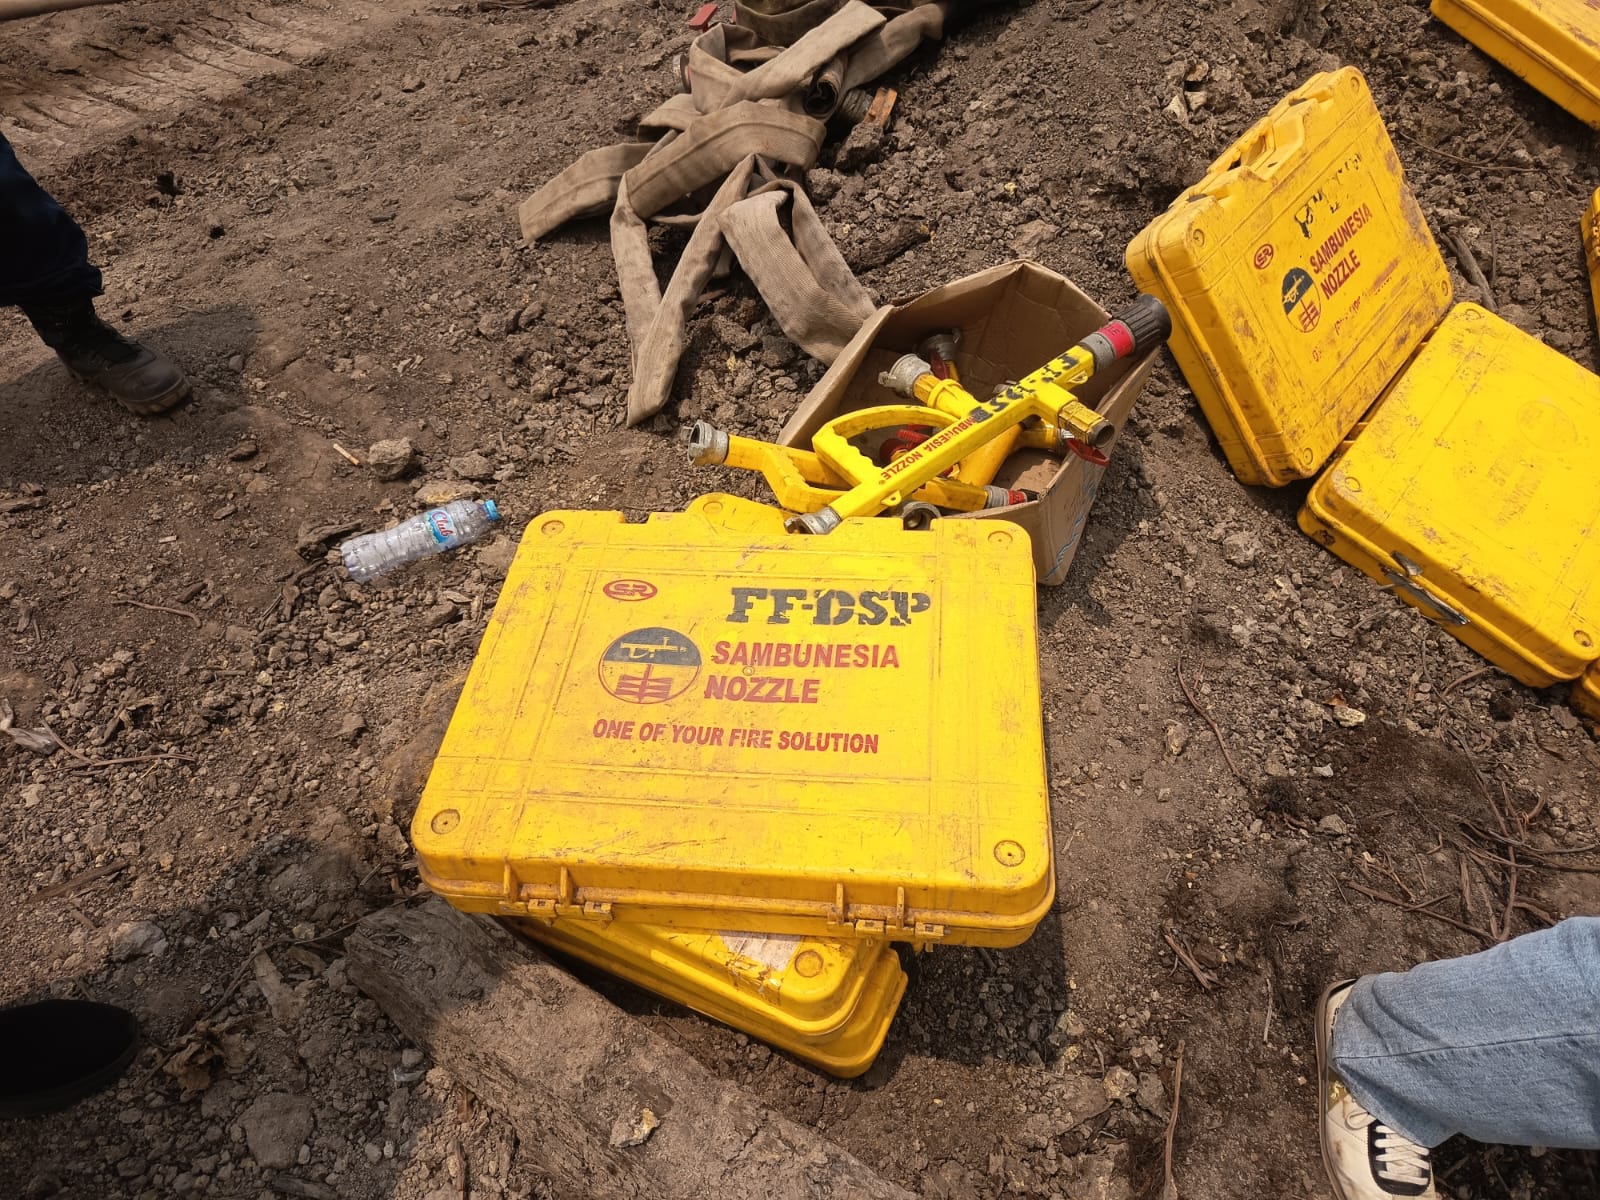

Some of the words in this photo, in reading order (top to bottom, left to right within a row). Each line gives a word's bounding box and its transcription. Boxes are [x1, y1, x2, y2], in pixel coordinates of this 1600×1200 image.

[1309, 202, 1373, 275] SAMBUNESIA
[1320, 249, 1361, 300] NOZZLE
[923, 412, 984, 453] MBUNESIA
[884, 451, 923, 481] NOZZLE
[431, 510, 454, 537] Club
[726, 587, 931, 627] FF-DSP
[711, 640, 900, 669] SAMBUNESIA
[703, 674, 821, 704] NOZZLE
[592, 718, 635, 740] ONE
[639, 722, 667, 743] OF
[672, 724, 725, 747] YOUR
[728, 728, 774, 750] FIRE
[778, 730, 879, 754] SOLUTION
